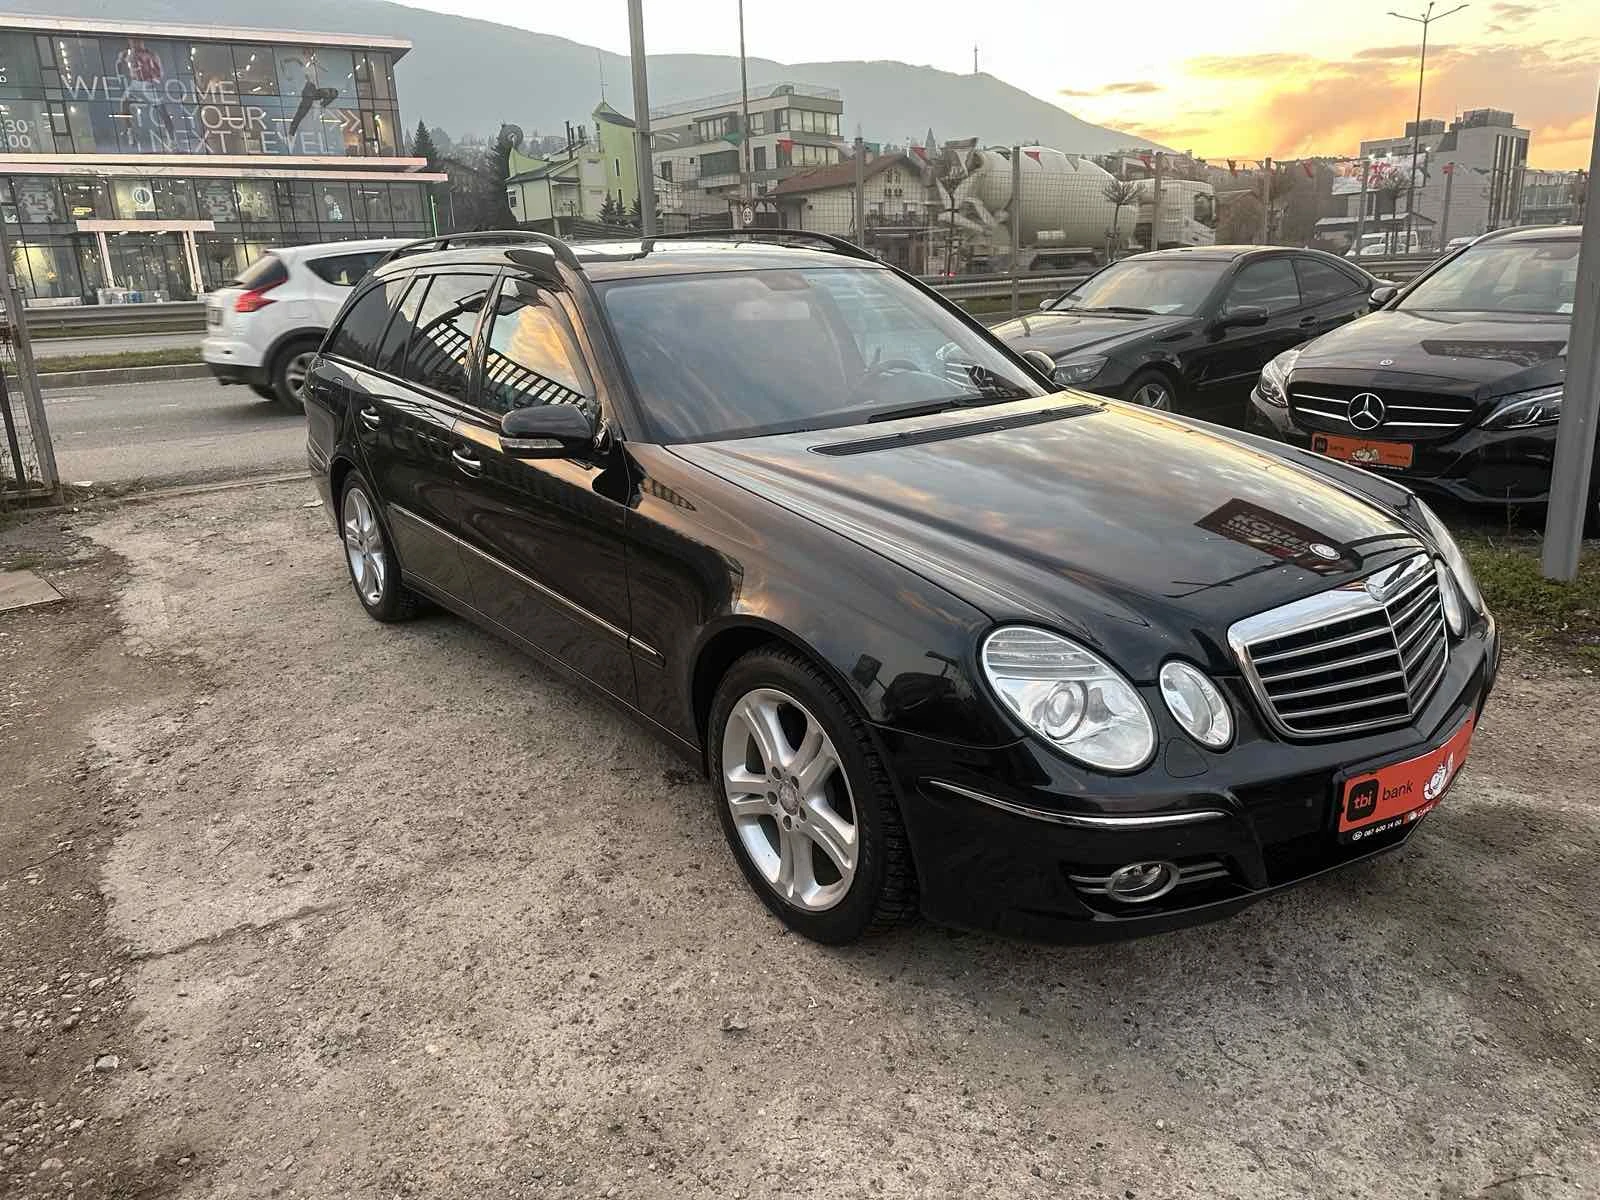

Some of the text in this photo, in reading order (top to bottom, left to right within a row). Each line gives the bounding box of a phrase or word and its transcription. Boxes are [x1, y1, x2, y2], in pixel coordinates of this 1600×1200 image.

[61, 75, 237, 104] WELCOME
[181, 104, 267, 129] YOUR
[150, 130, 337, 154] NEXT LEVEL
[1354, 780, 1413, 809] tbi bank
